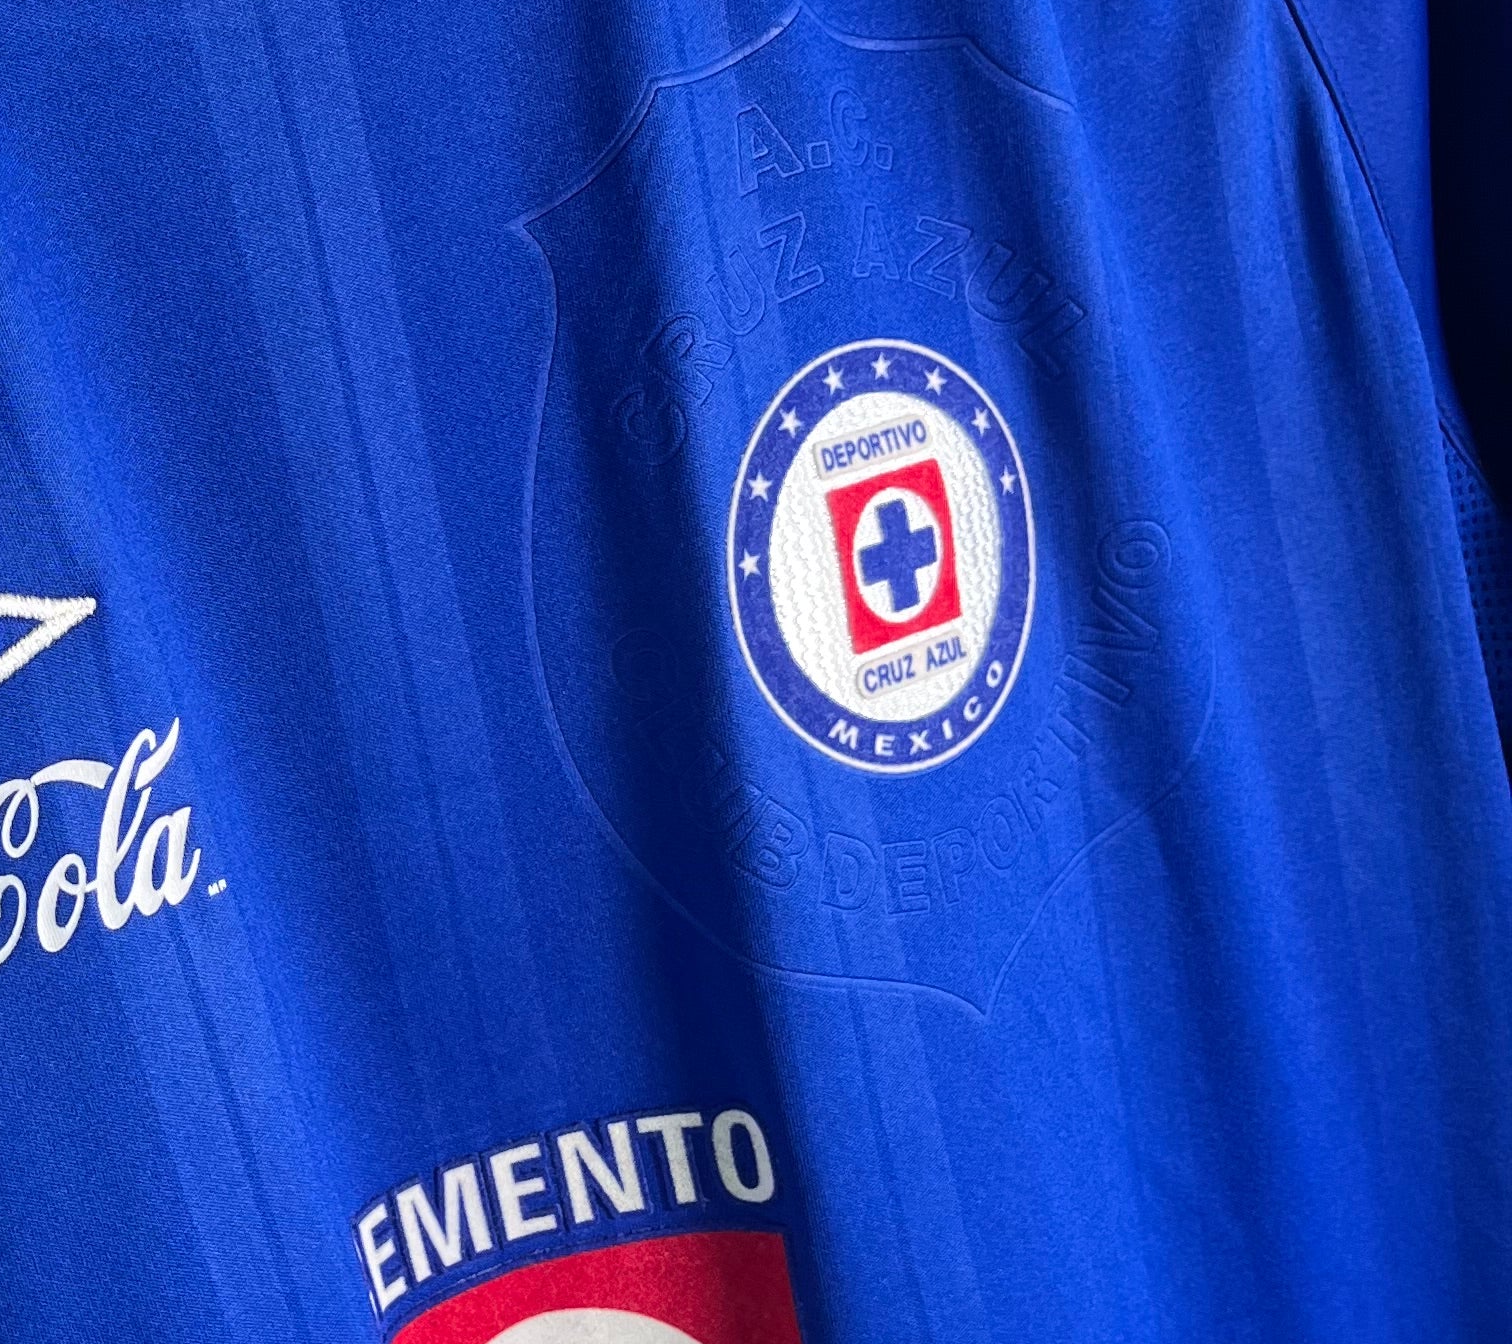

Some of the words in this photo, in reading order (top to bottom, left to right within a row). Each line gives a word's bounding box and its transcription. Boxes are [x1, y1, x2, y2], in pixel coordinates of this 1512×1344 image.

[734, 88, 894, 198] A.C.
[611, 210, 826, 464] CRUZ
[851, 202, 1087, 383] AZUL
[821, 419, 928, 472] DEPORTIVO
[818, 519, 1172, 915] DEPORTIVO
[827, 659, 1004, 756] MEXICO
[863, 654, 916, 694] CRUZ
[925, 636, 968, 669] AZUL
[353, 1108, 777, 1314] EMENTO
